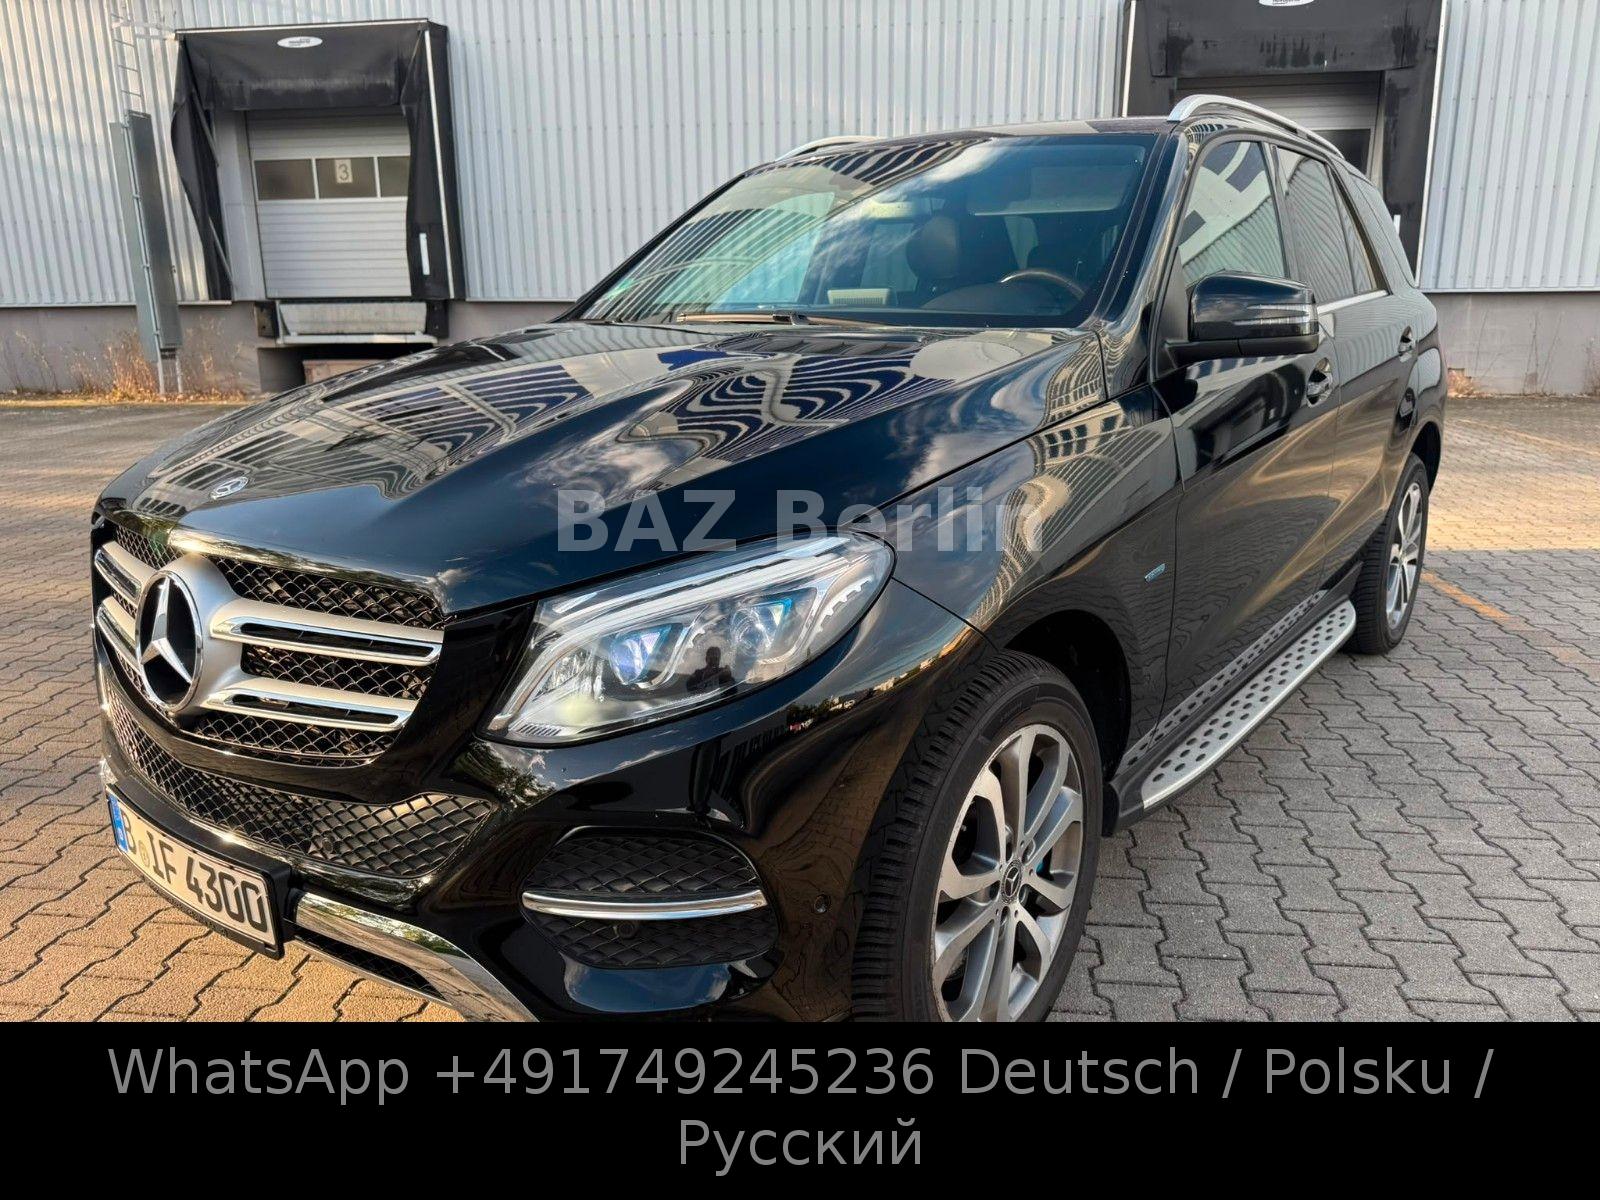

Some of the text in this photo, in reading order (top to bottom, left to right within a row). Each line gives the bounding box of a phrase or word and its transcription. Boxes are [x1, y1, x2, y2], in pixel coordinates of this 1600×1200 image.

[339, 164, 349, 180] 3
[146, 830, 177, 884] IF
[186, 856, 268, 933] 4300
